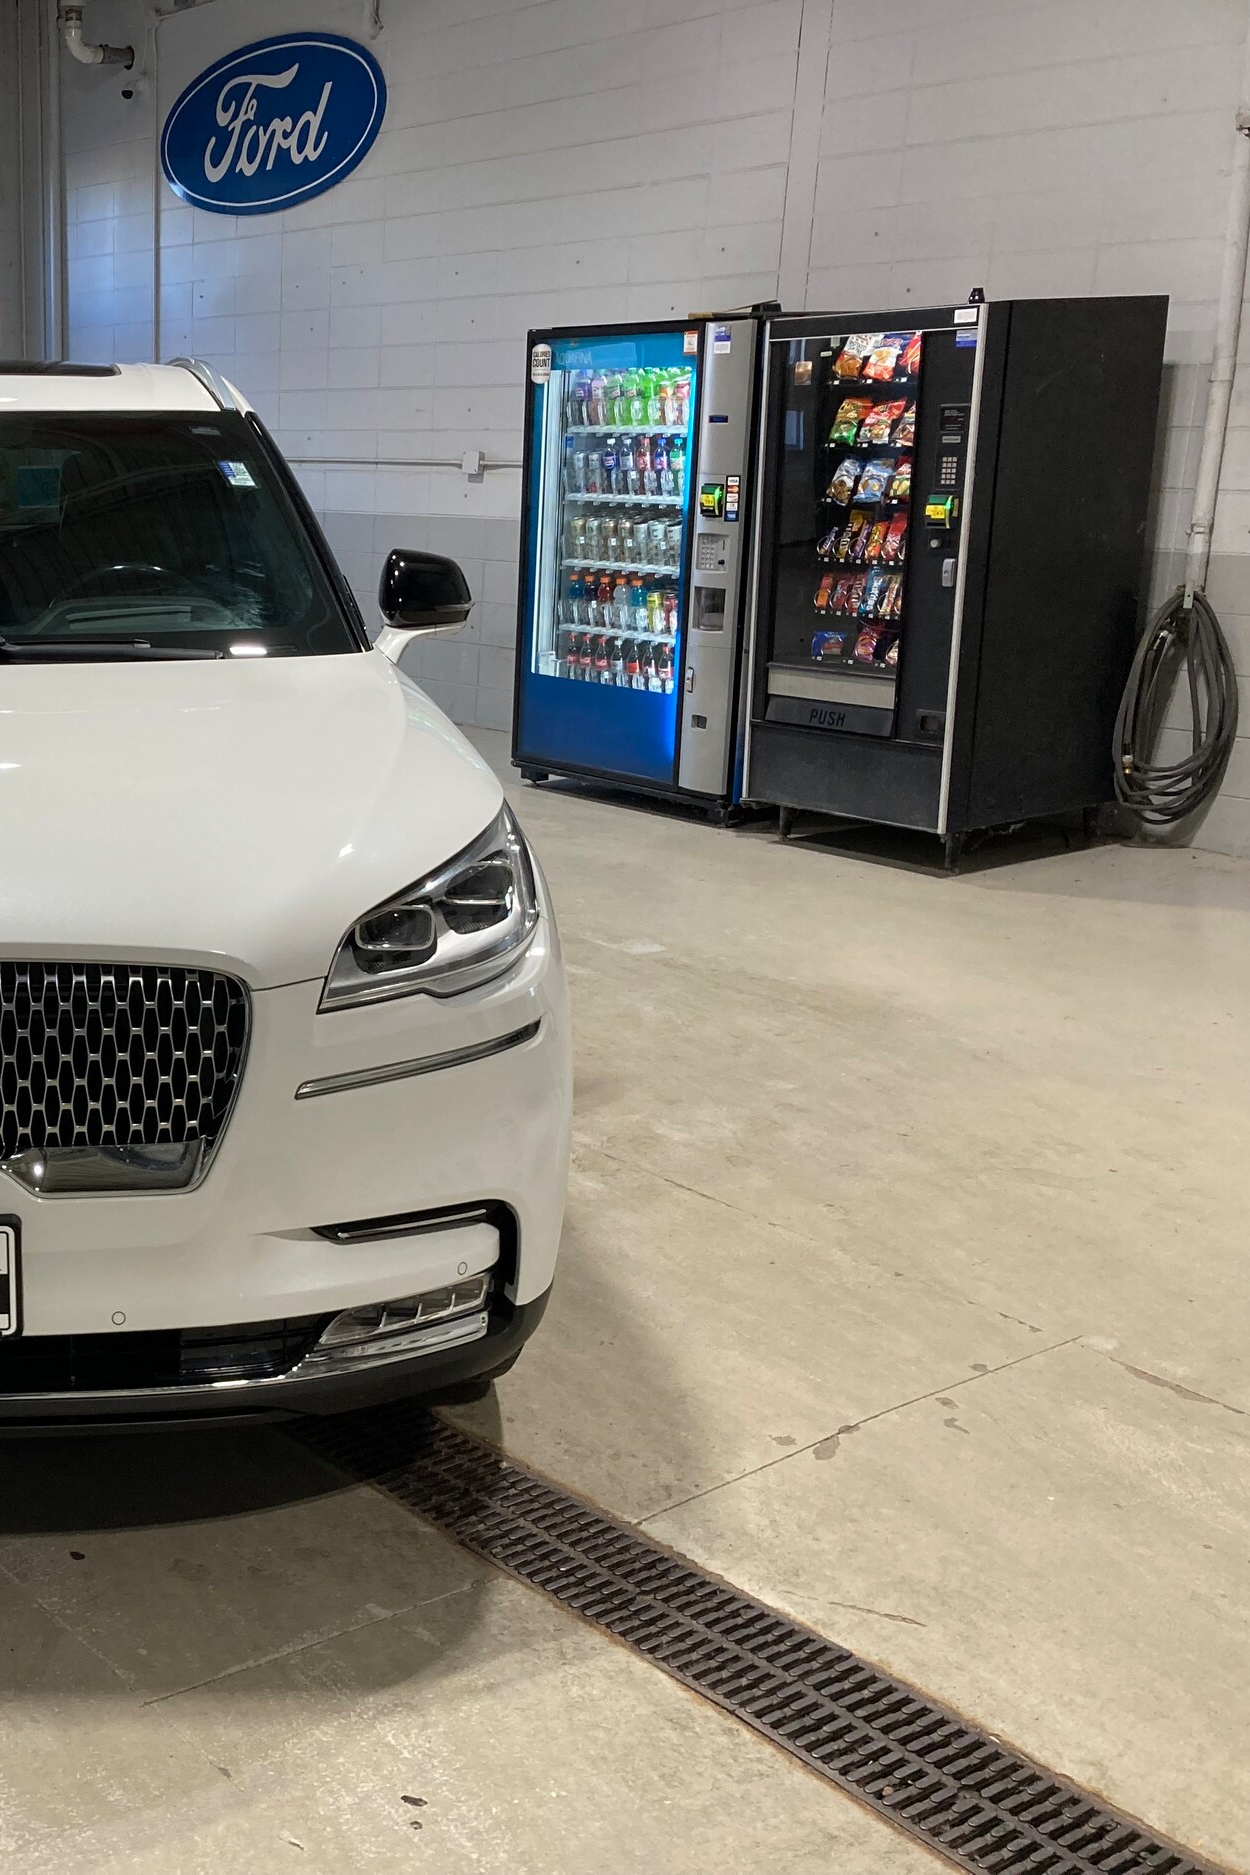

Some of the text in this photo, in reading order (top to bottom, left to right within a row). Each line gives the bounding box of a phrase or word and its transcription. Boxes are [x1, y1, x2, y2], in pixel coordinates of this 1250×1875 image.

[203, 62, 333, 184] Ford
[532, 358, 551, 368] COUNT
[809, 708, 846, 727] PUSH
